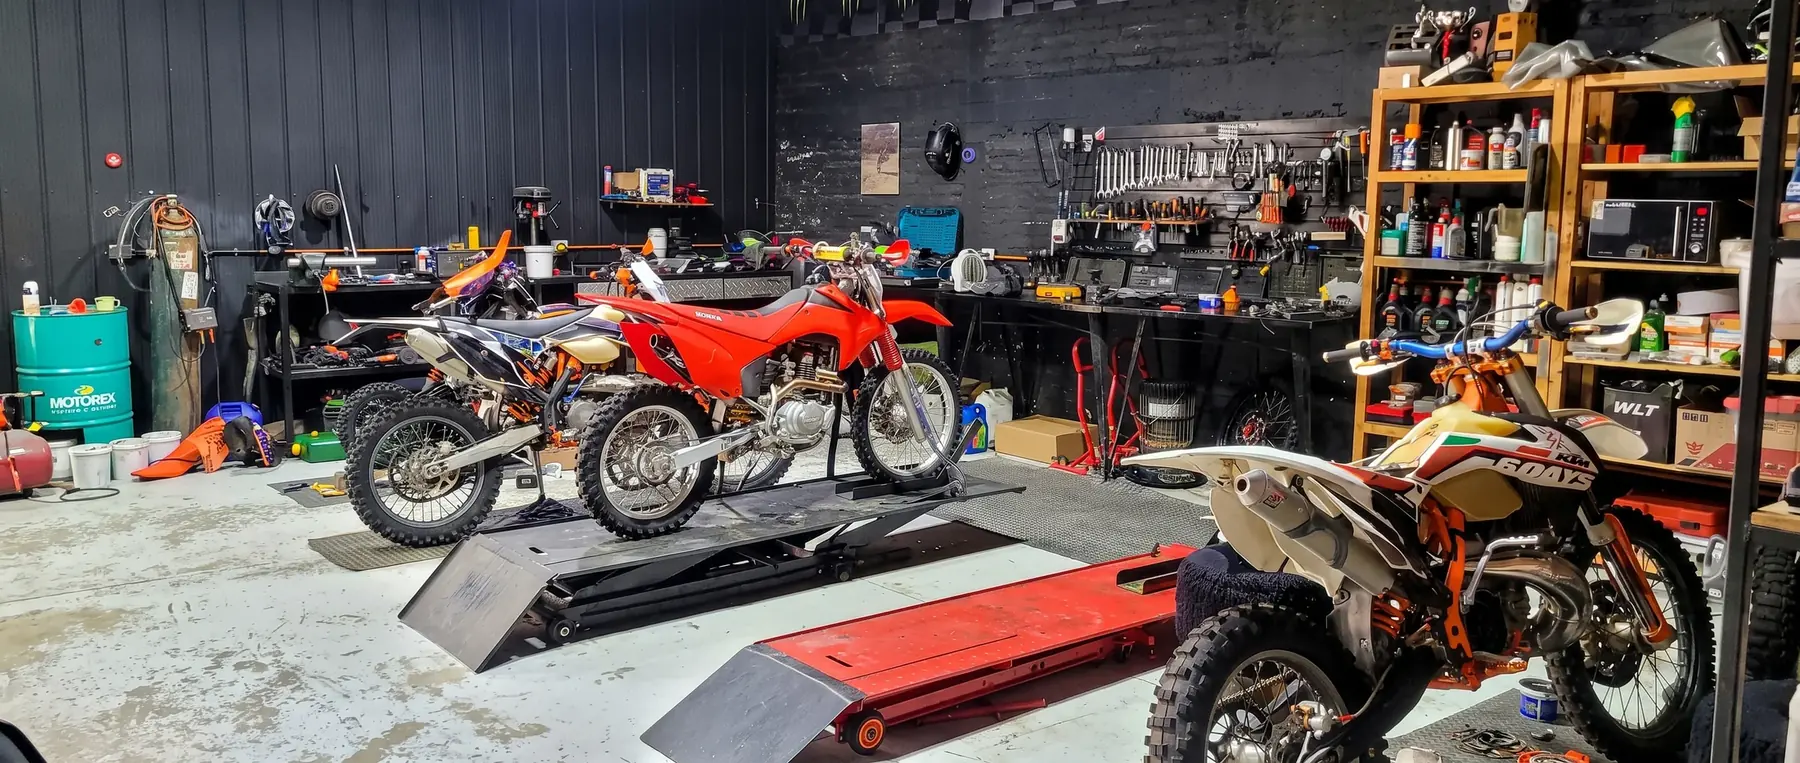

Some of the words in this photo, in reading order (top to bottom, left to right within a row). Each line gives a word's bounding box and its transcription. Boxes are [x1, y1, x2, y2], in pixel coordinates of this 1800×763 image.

[50, 392, 116, 409] MOTOREX
[1613, 401, 1660, 417] WLT
[1555, 453, 1590, 468] KTM
